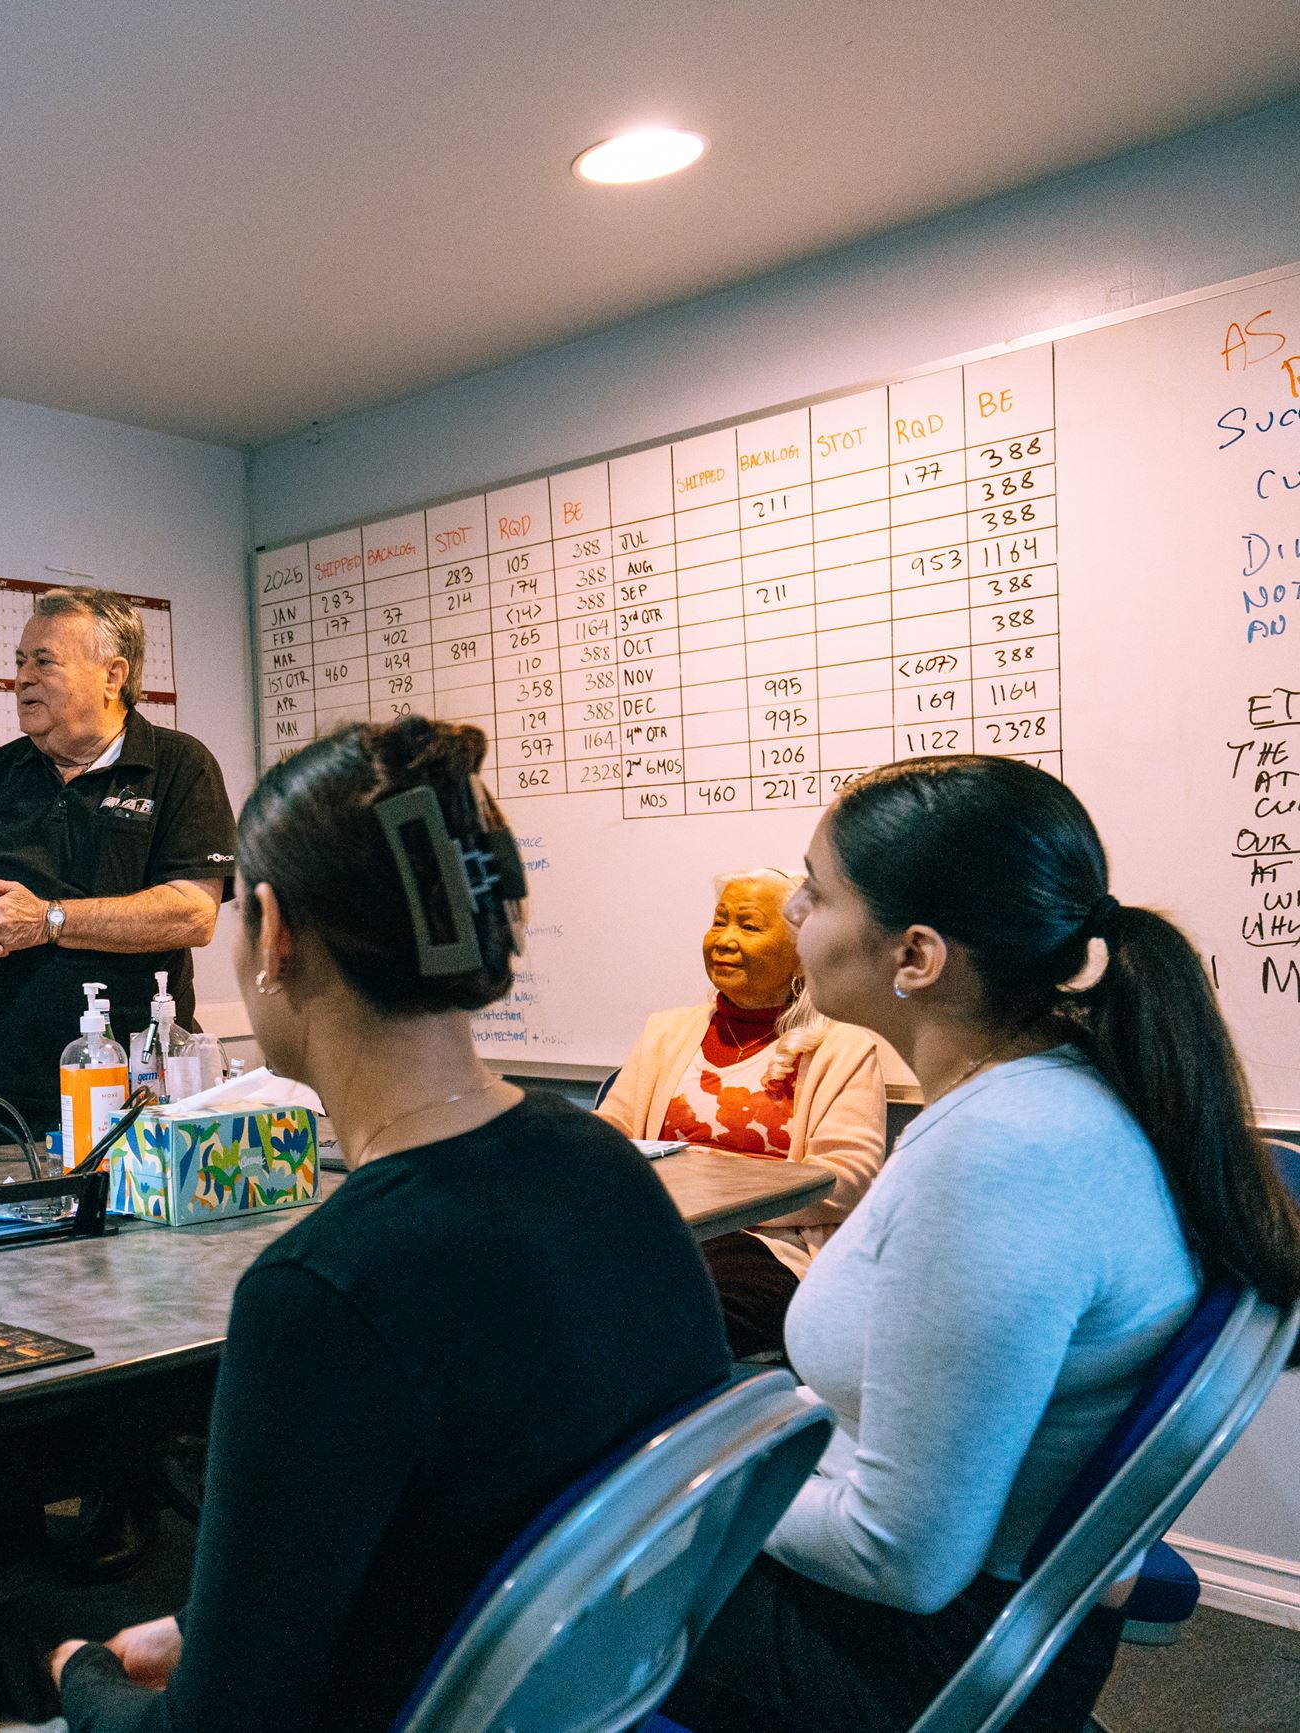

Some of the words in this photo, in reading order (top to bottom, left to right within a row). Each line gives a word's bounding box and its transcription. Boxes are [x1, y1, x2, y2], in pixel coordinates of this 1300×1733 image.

[978, 390, 1014, 419] BE
[896, 413, 944, 445] RQD
[816, 427, 867, 458] STOT
[980, 437, 1042, 469] 388
[740, 444, 799, 472] BACKLOG
[676, 468, 725, 495] SHIPPED
[905, 462, 943, 486] 177
[981, 470, 1035, 502] 388
[563, 501, 584, 525] BE
[753, 495, 788, 518] 211
[498, 515, 532, 540] RQD
[981, 503, 1036, 533] 388
[435, 525, 471, 553] STOT
[572, 538, 601, 559] 388
[619, 530, 650, 551] JUL
[367, 542, 416, 566] BACKLOG
[507, 552, 531, 574] 105
[911, 549, 962, 577] 953
[983, 536, 1038, 569] 1164
[315, 555, 362, 581] SHIPPED
[445, 566, 474, 587] 283
[575, 566, 607, 588] 388
[627, 560, 654, 576] AUG
[263, 566, 303, 593] 2025
[510, 578, 538, 598] 174
[987, 574, 1035, 597] 388
[321, 590, 354, 613] 283
[448, 592, 472, 611] 214
[576, 591, 605, 611] 388
[620, 584, 649, 602] SEP
[756, 584, 787, 604] 211
[271, 606, 296, 626] JAN
[326, 617, 350, 636] 177
[383, 607, 403, 625] 37
[619, 611, 640, 632] 3rd
[641, 608, 663, 625] QTR
[992, 608, 1036, 632] 388
[273, 631, 294, 646] FEB
[383, 629, 408, 647] 402
[509, 628, 541, 649] 265
[575, 618, 609, 641] 1164
[450, 641, 476, 660] 899
[580, 646, 610, 664] 388
[623, 637, 654, 658] OCT
[996, 647, 1036, 668] 388
[273, 652, 297, 669] MAR
[385, 652, 410, 671] 439
[518, 657, 542, 674] 110
[325, 665, 348, 683] 460
[389, 675, 413, 694] 278
[585, 670, 615, 691] 388
[624, 669, 654, 686] NOV
[517, 679, 554, 702] 358
[764, 677, 803, 698] 995
[990, 680, 1037, 706] 1164
[277, 697, 297, 715] APR
[391, 702, 411, 720] 30
[583, 701, 615, 721] 388
[624, 697, 656, 717] DEC
[916, 689, 956, 712] 169
[277, 720, 298, 739] MAY
[521, 711, 547, 732] 129
[765, 708, 807, 733] 995
[986, 716, 1046, 745] 2328
[584, 730, 617, 751] 1164
[646, 726, 668, 743] QTR
[906, 729, 958, 752] 1122
[521, 738, 554, 759] 597
[760, 746, 805, 768] 1206
[626, 757, 642, 778] 2nd
[1227, 741, 1289, 779] THE
[518, 769, 551, 789] 862
[581, 763, 622, 784] 2328
[640, 793, 668, 809] MOS
[698, 785, 735, 806] 460
[1236, 829, 1291, 852] OUR
